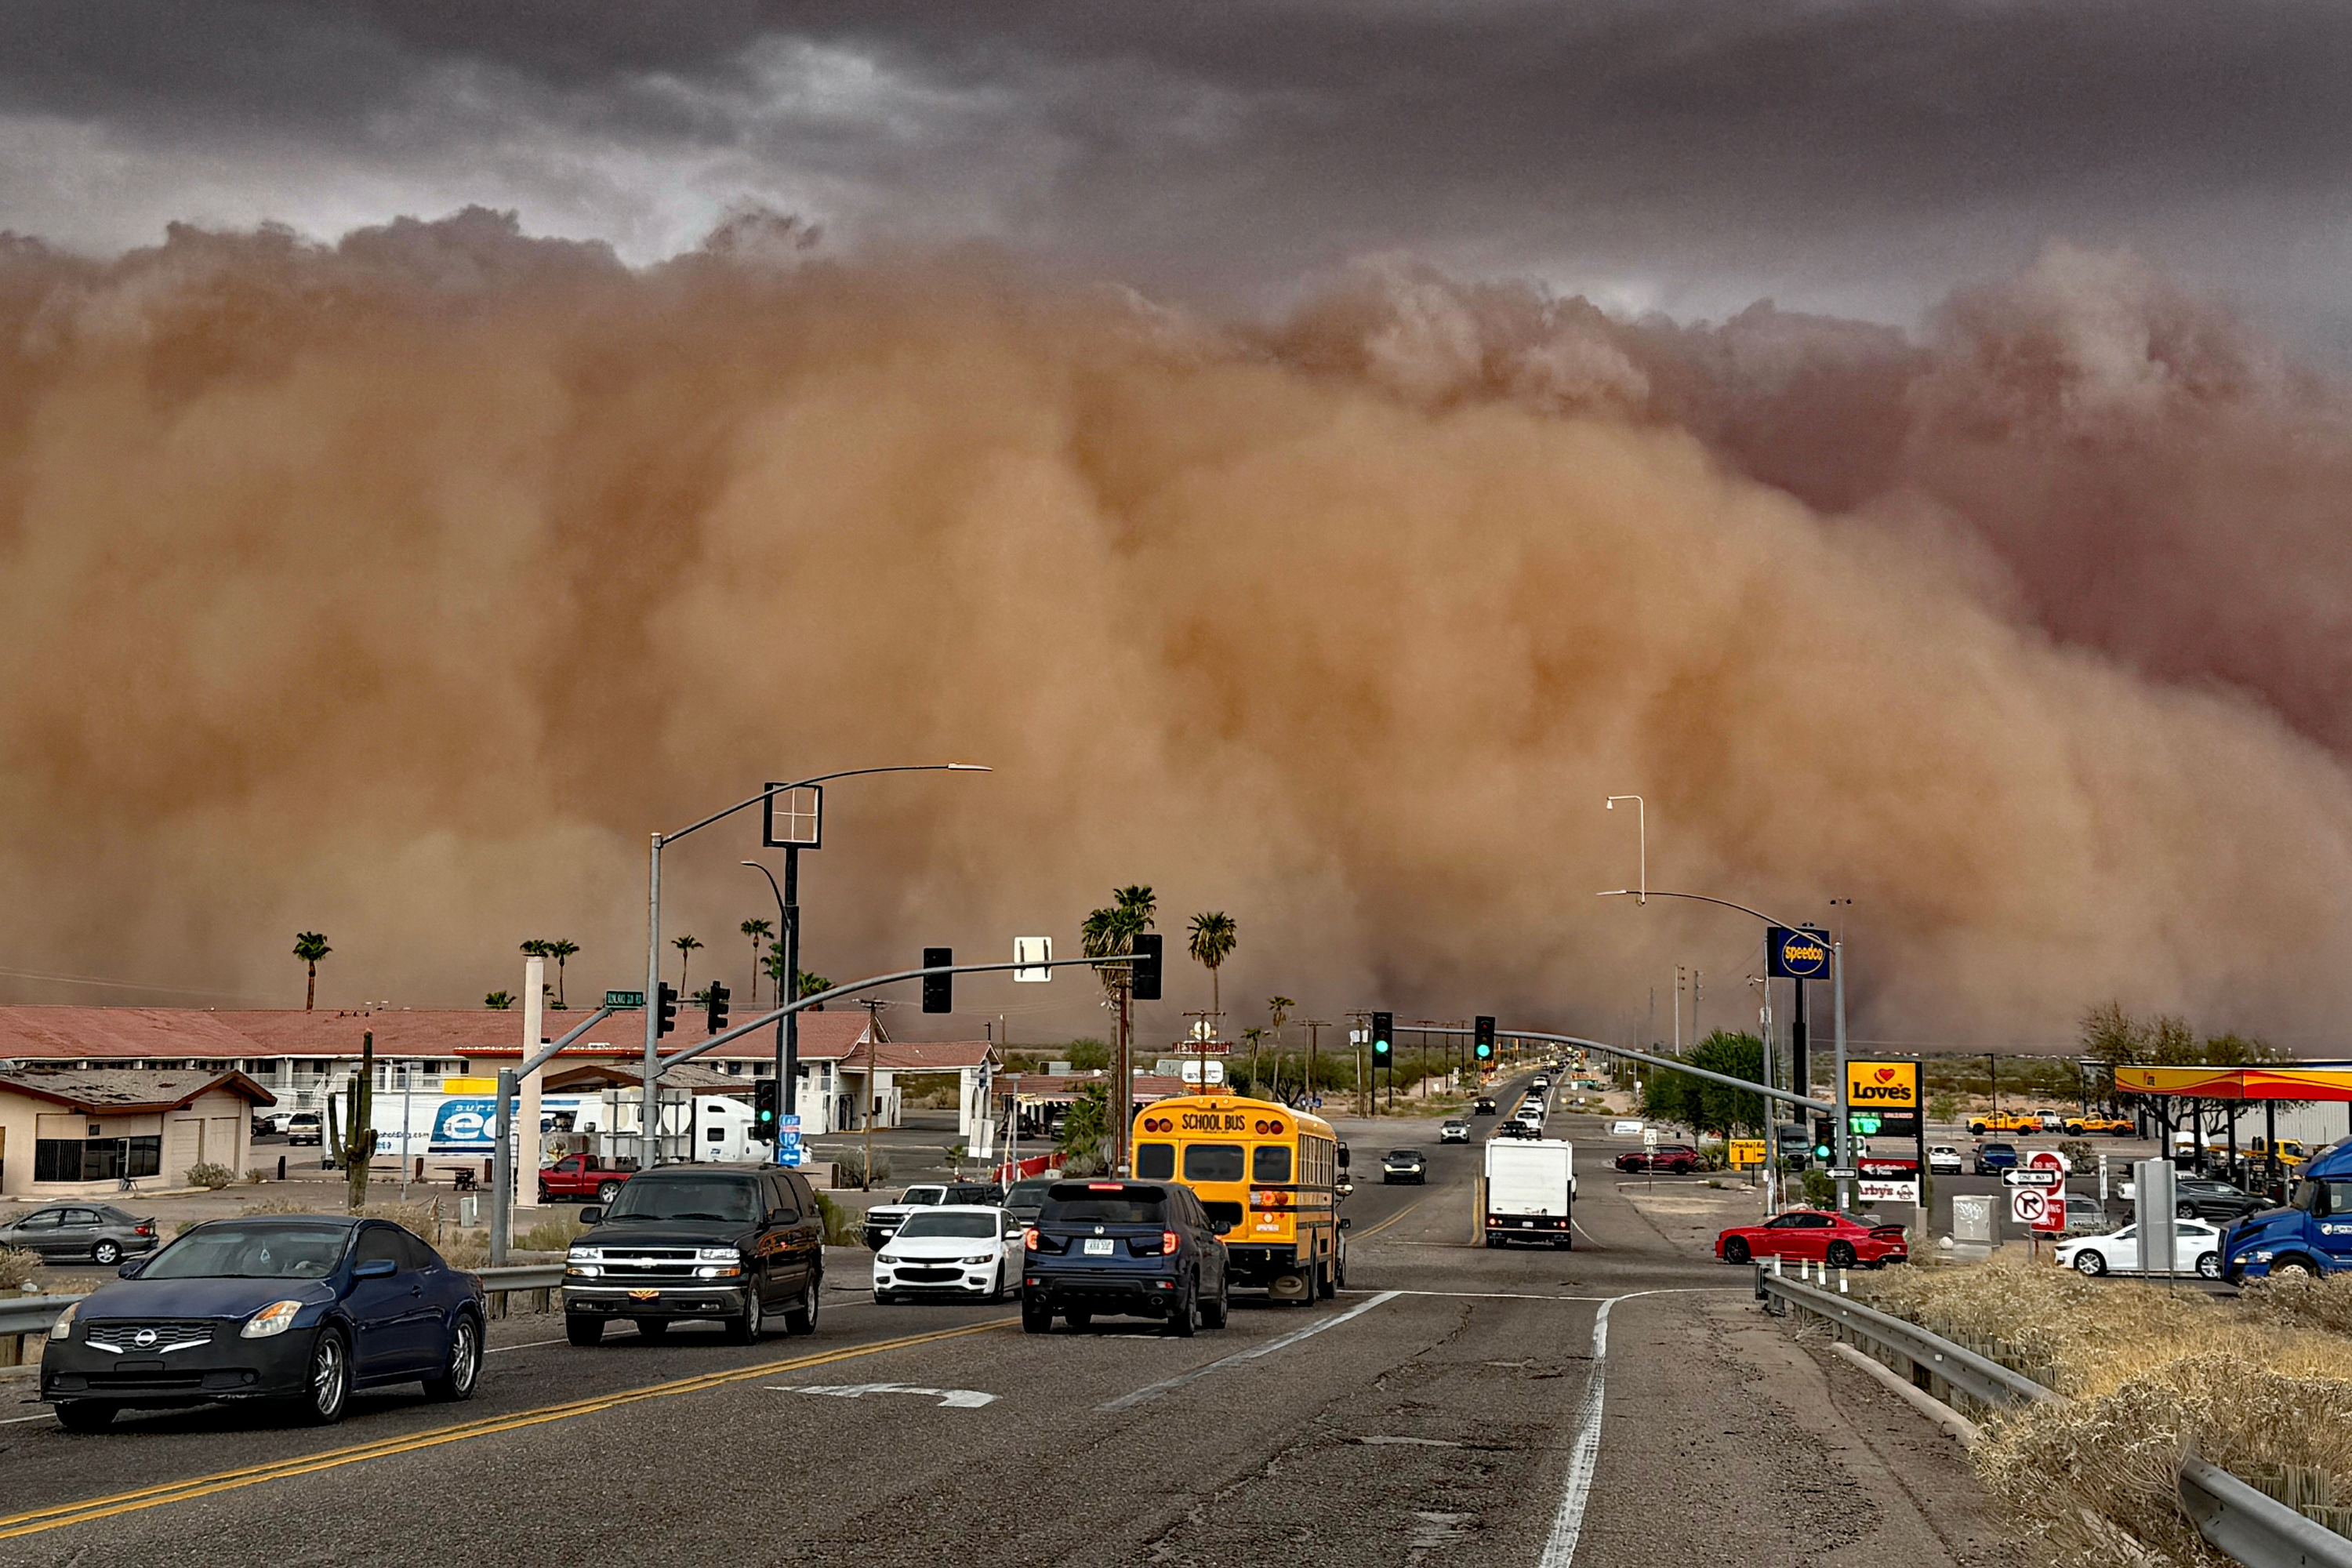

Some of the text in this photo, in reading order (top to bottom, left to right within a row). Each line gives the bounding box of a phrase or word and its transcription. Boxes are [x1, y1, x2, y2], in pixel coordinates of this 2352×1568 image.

[1785, 943, 1824, 963] speedco
[1853, 1082, 1911, 1100] Love's
[1182, 1114, 1245, 1131] SCHOOL BUS
[785, 1133, 796, 1145] 10
